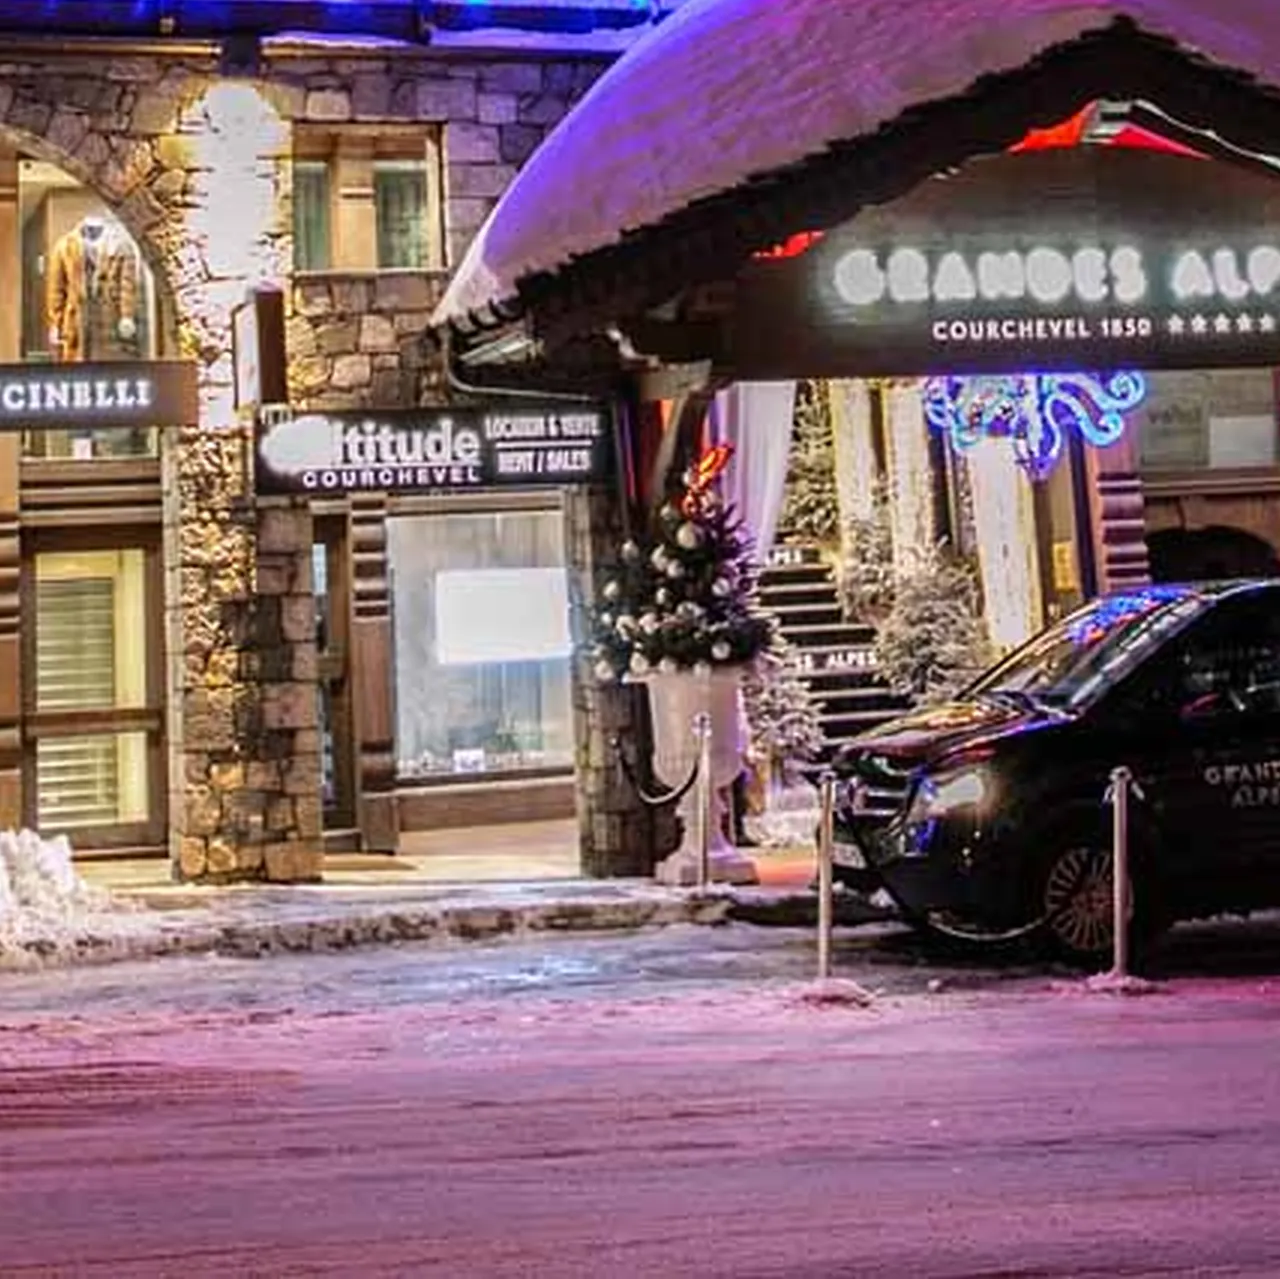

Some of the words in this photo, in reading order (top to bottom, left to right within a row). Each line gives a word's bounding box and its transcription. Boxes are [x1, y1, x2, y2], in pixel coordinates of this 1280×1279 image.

[834, 246, 1146, 303] GRANDES
[932, 320, 1092, 341] COURCHEVEL
[1101, 319, 1152, 336] 1850
[260, 416, 481, 469] ltitude
[302, 469, 480, 487] COURCHEVEL
